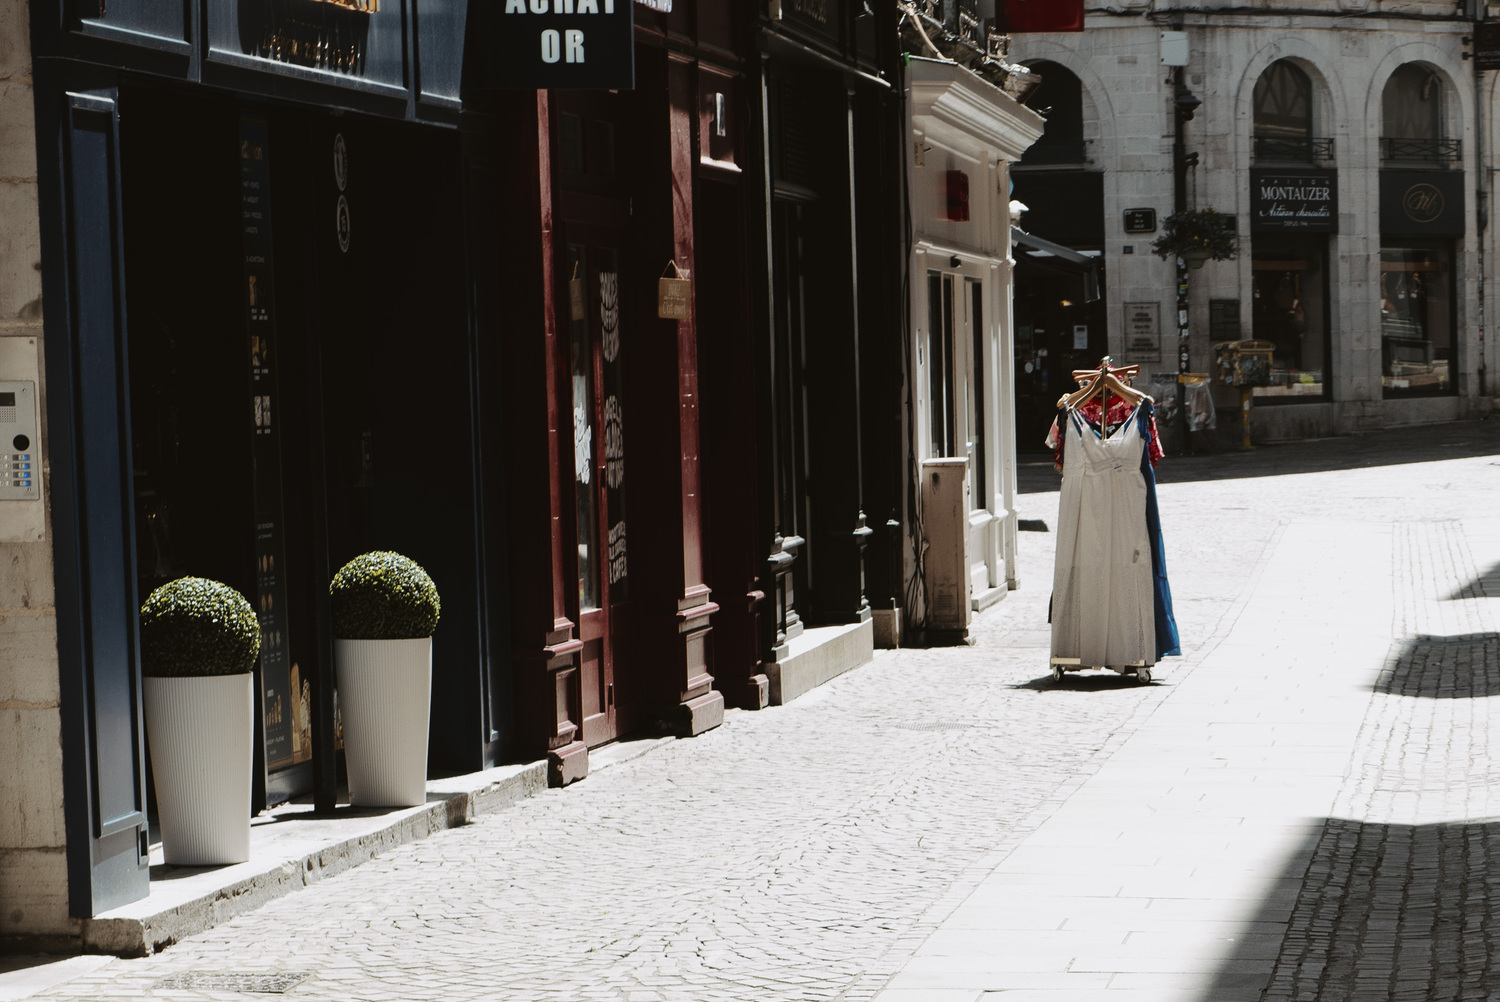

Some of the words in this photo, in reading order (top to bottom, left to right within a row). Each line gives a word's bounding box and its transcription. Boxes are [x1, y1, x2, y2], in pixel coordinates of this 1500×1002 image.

[540, 28, 586, 64] OR
[1261, 186, 1331, 201] MONTAUZER
[1259, 202, 1294, 217] Artisan
[1295, 203, 1331, 217] charcutier
